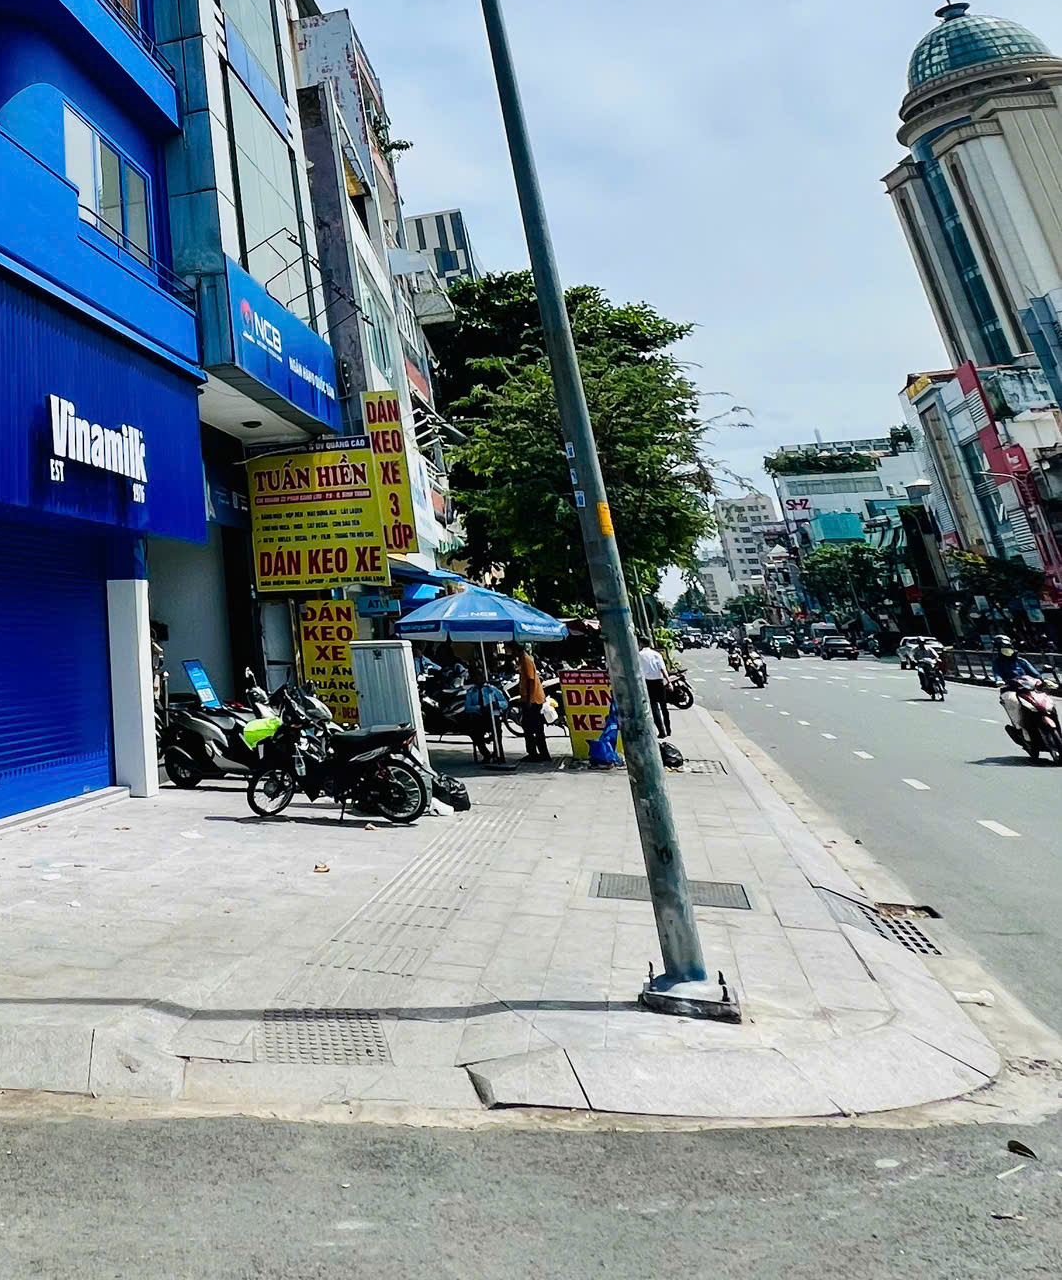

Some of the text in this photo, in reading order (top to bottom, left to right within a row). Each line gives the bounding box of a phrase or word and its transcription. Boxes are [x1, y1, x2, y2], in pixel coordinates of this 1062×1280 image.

[254, 311, 282, 354] NCB
[365, 395, 399, 424] DÁN
[50, 393, 148, 483] Vinamilk
[370, 430, 403, 454] KEO
[50, 459, 64, 482] EST
[254, 454, 368, 492] TUẤN HIỀN
[380, 461, 402, 485] XE
[389, 492, 400, 517] 3
[383, 520, 414, 551] LỚP
[260, 546, 382, 577] DÁN KEO XE
[303, 602, 352, 622] DÁN
[303, 625, 353, 641] KEO
[315, 645, 347, 661] XE
[311, 666, 325, 675] IN
[566, 686, 613, 706] DÁN
[572, 714, 605, 731] KE
